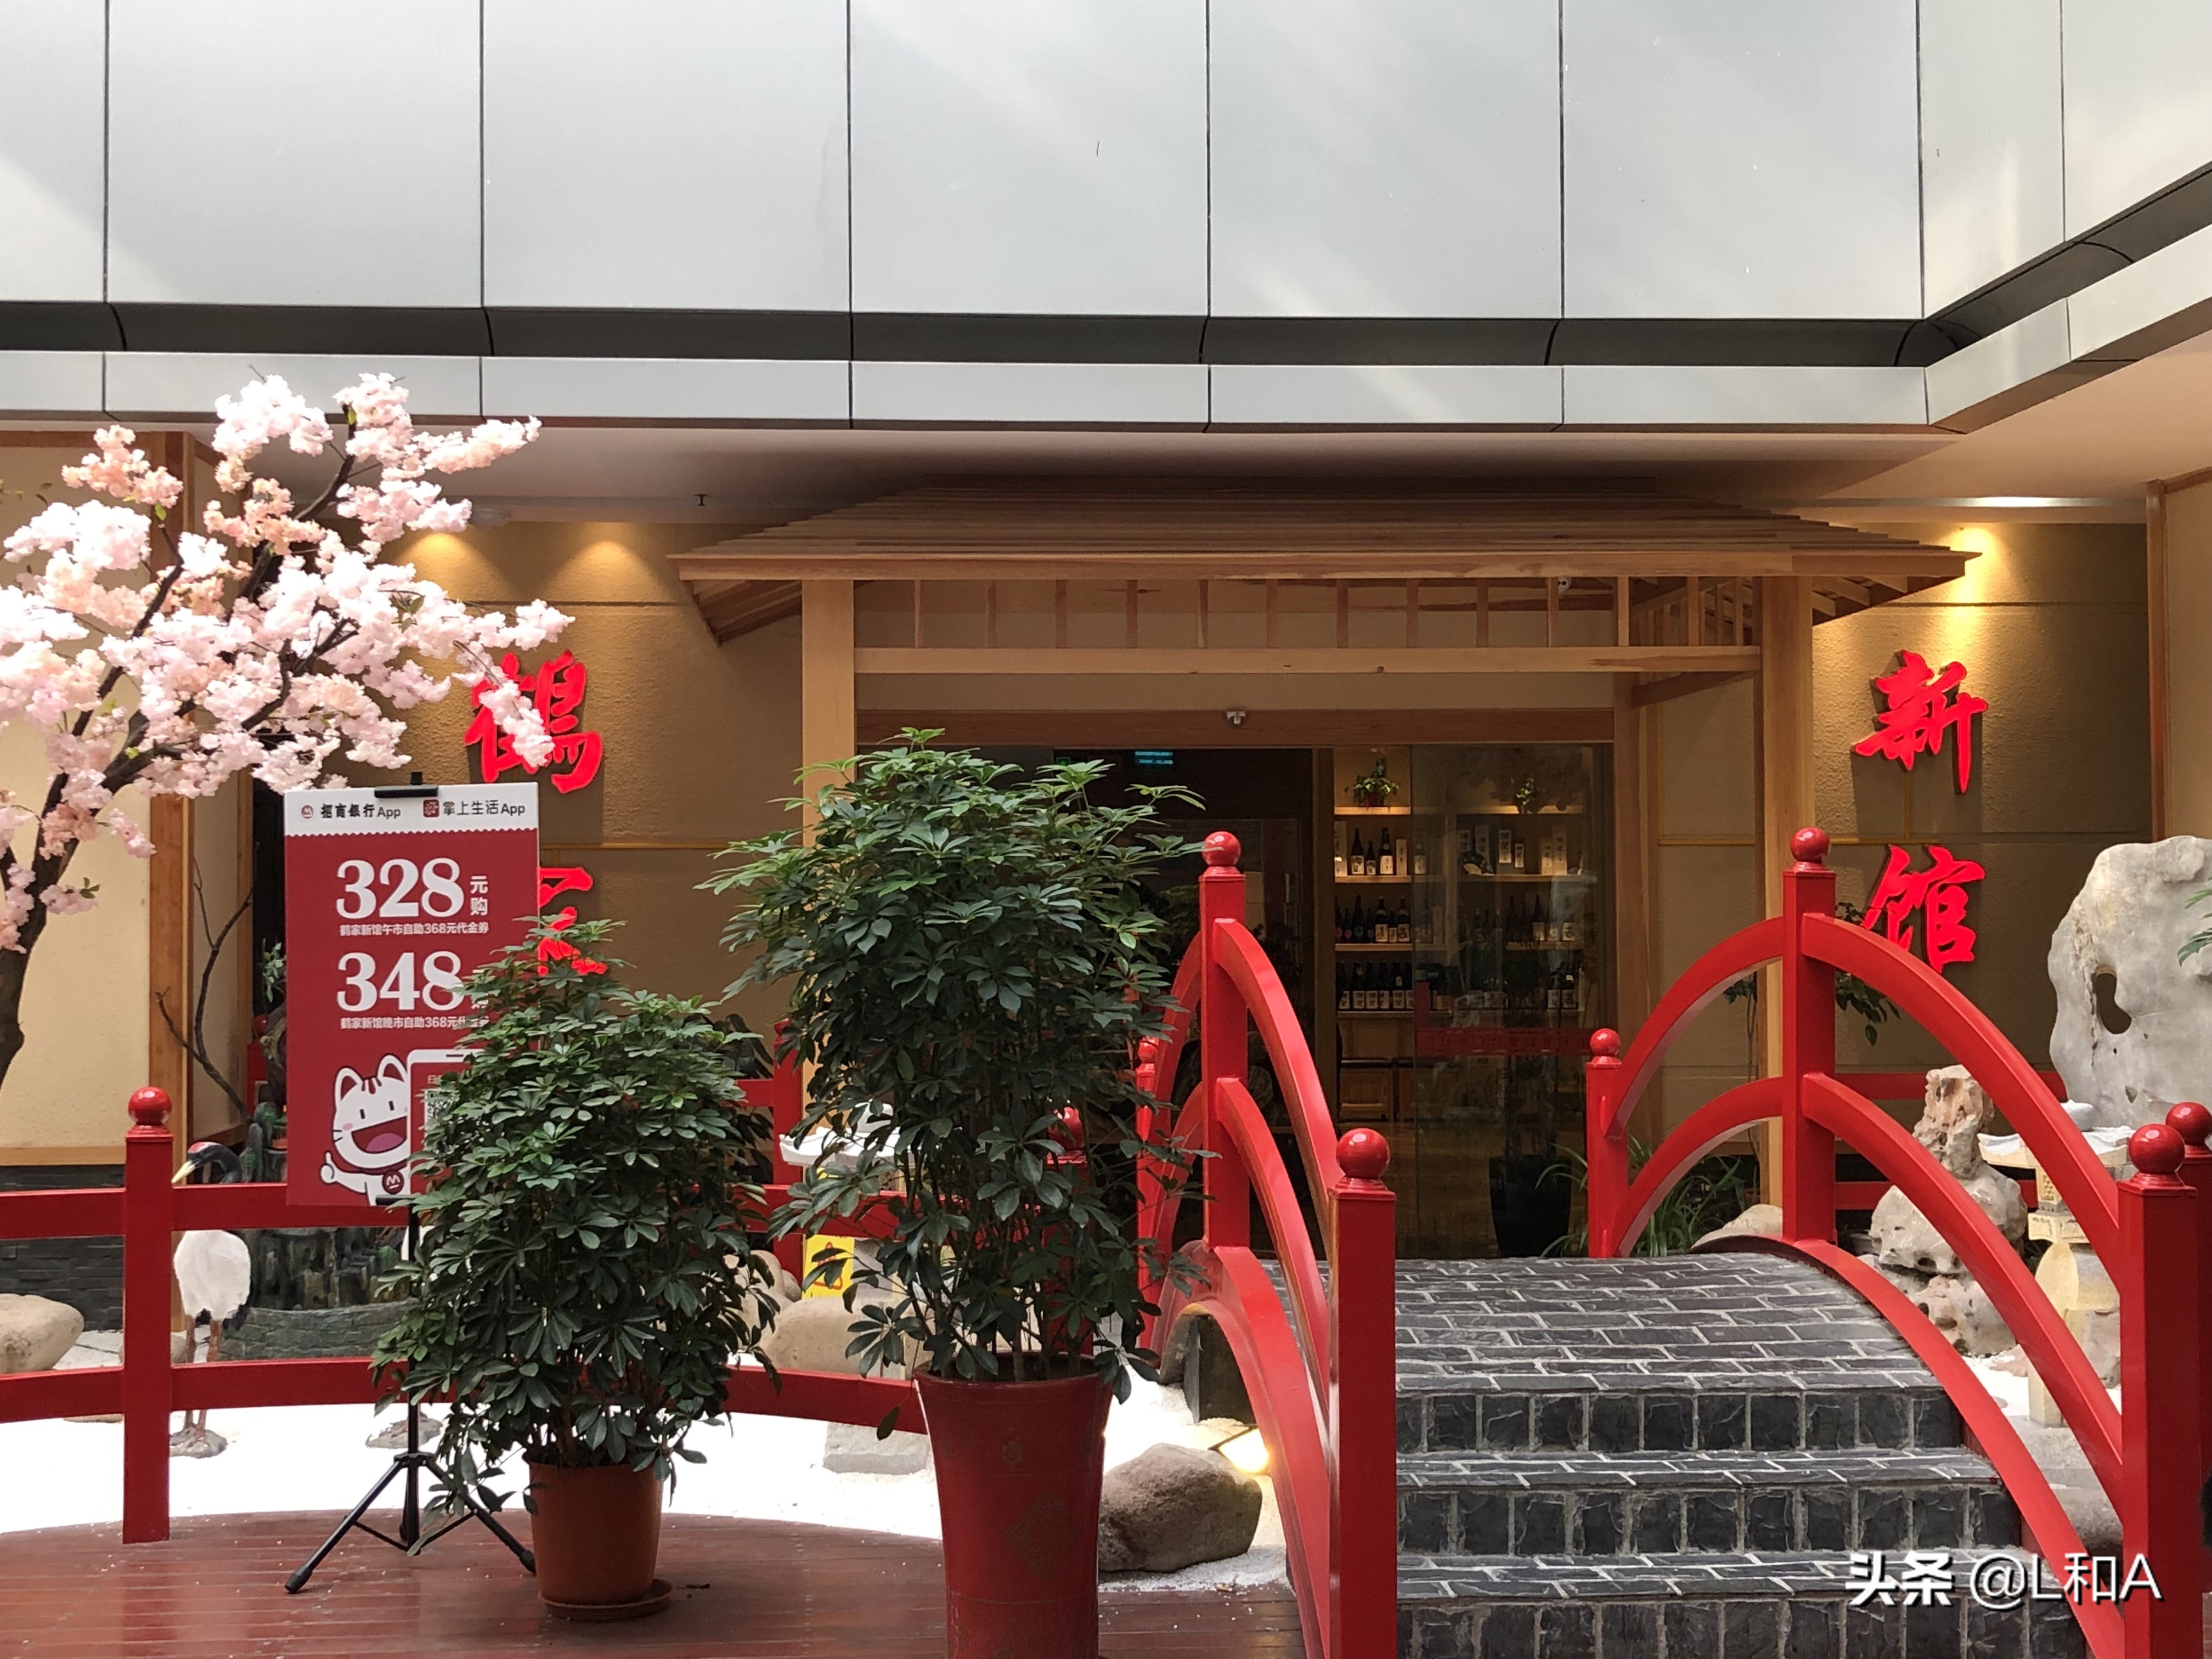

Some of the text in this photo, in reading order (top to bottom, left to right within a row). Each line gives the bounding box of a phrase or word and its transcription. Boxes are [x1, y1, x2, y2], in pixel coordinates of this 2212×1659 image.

[443, 799, 526, 816] 掌上生活App
[336, 857, 489, 919] 328 元购
[337, 951, 465, 1012] 348
